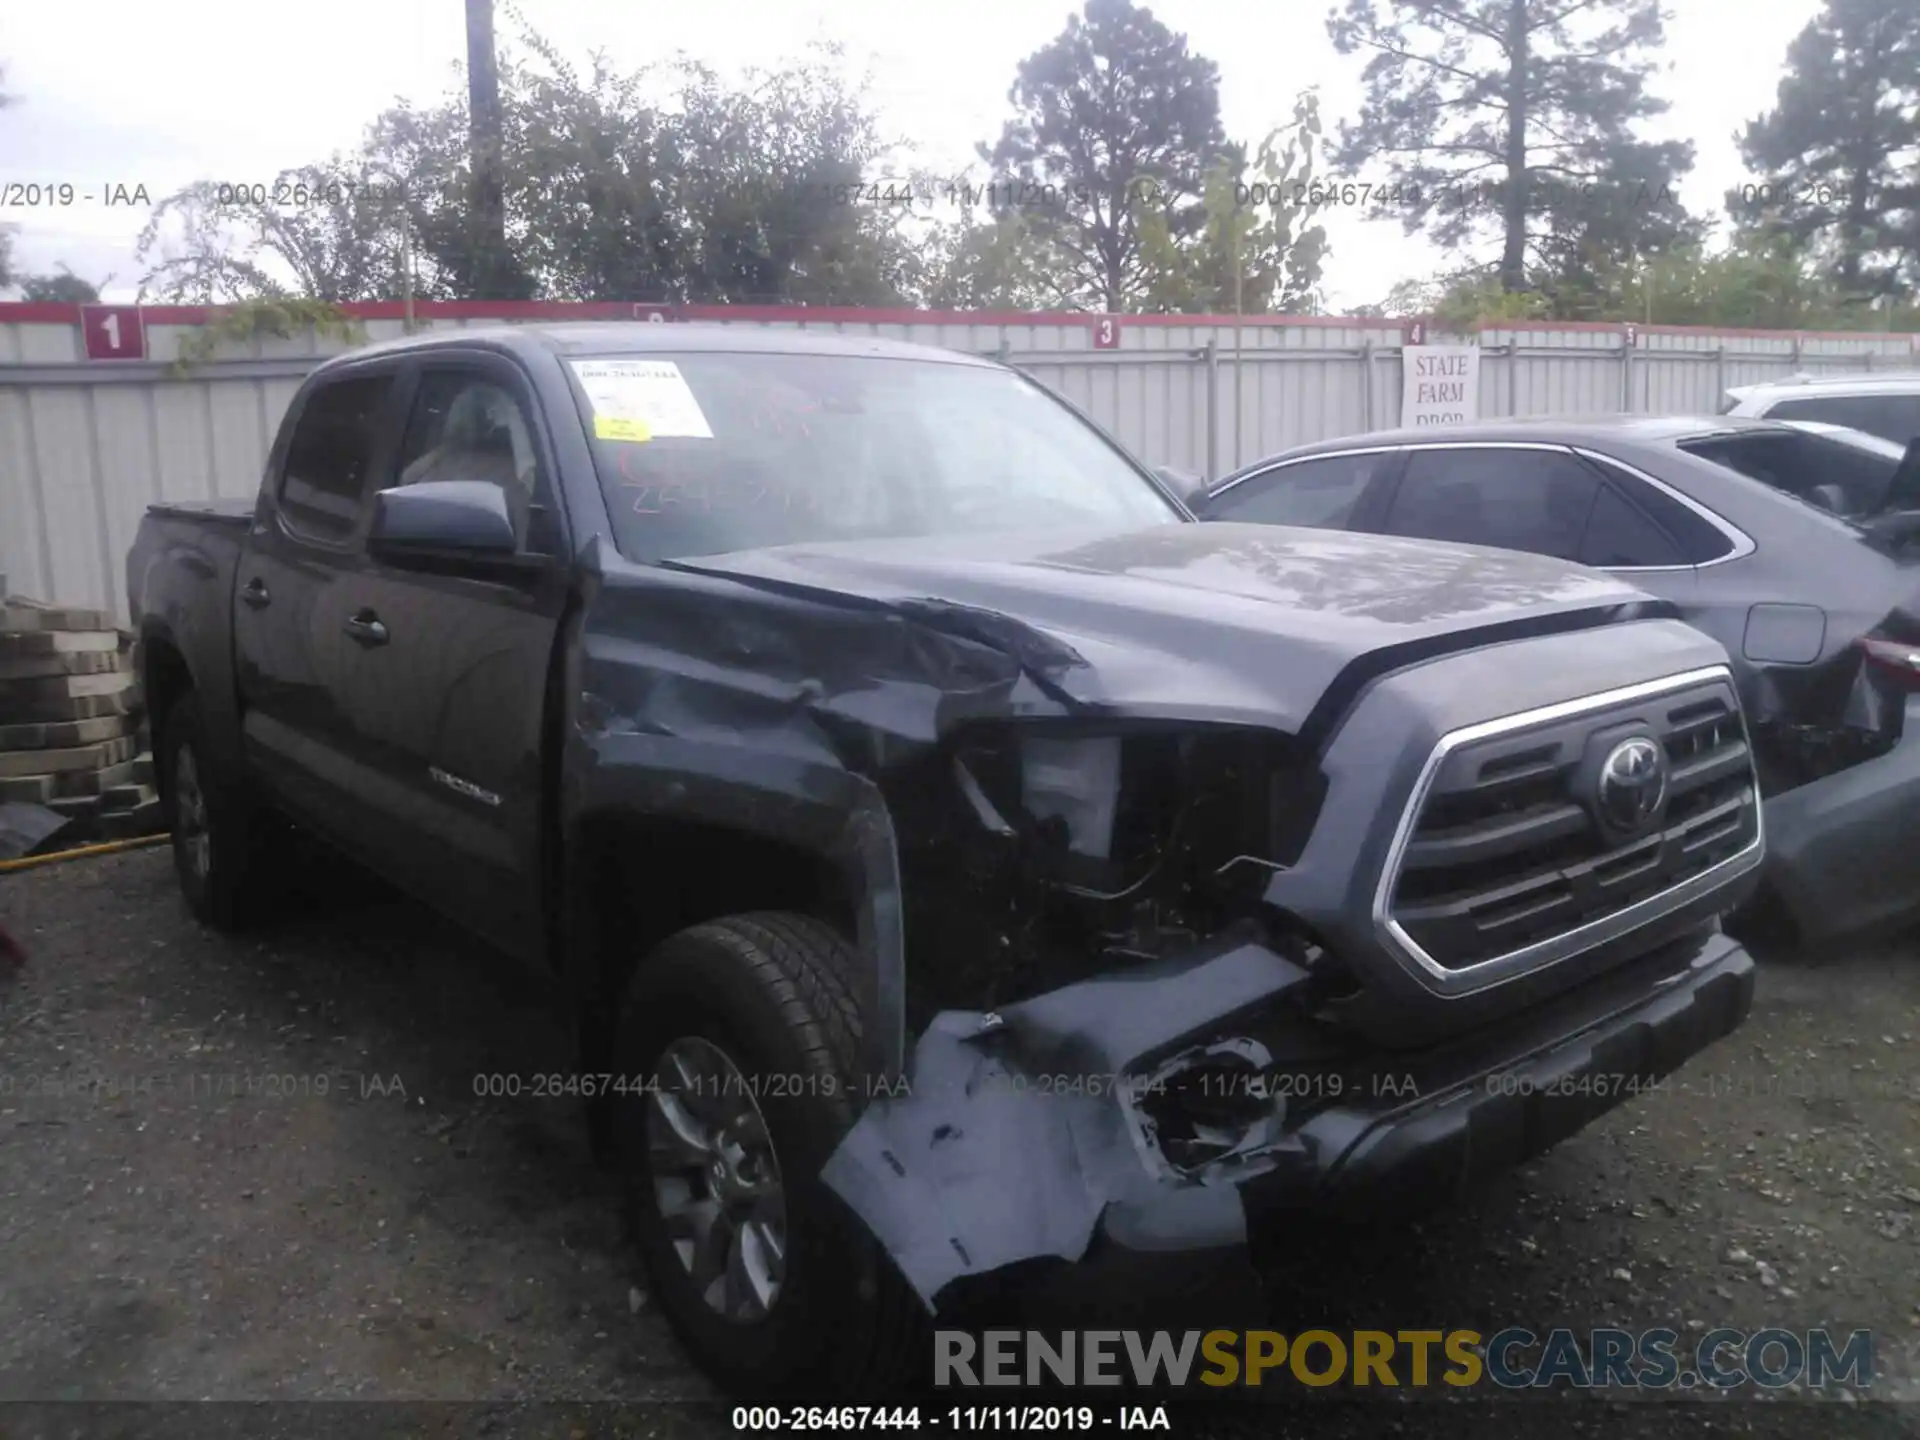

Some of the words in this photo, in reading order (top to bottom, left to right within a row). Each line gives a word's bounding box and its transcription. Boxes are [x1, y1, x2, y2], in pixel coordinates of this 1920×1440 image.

[101, 313, 120, 349] 1
[1101, 320, 1112, 343] 3
[1411, 323, 1421, 343] 4
[1416, 355, 1468, 376] STATE
[1417, 382, 1464, 403] FARM
